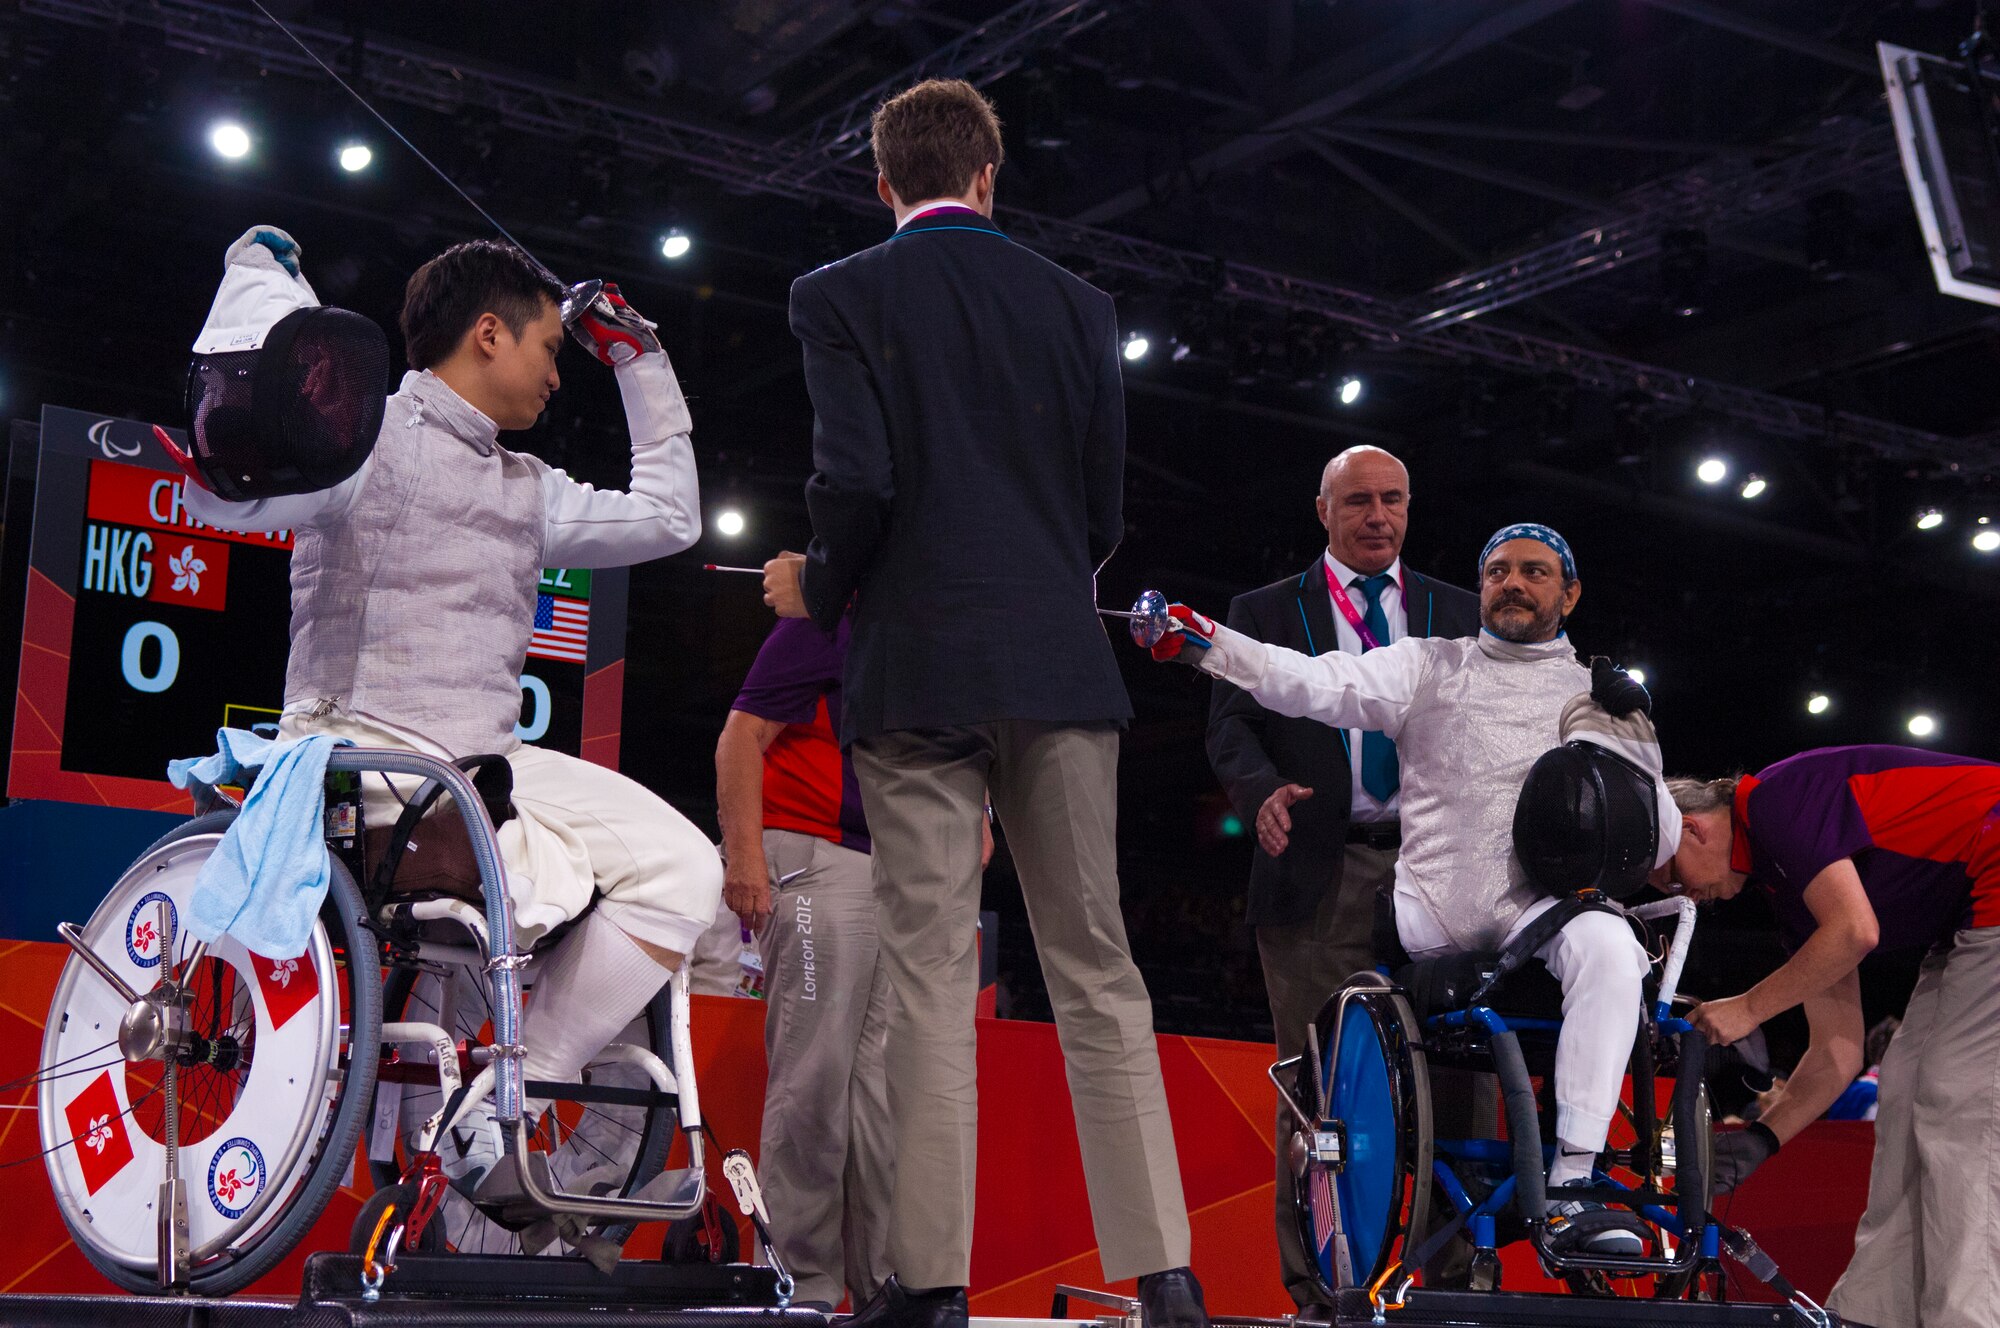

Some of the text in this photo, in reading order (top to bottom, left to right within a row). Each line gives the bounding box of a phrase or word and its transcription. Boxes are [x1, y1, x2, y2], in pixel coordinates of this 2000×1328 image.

[83, 525, 153, 598] HKG
[121, 621, 180, 693] 0
[796, 895, 817, 1001] London 2012
